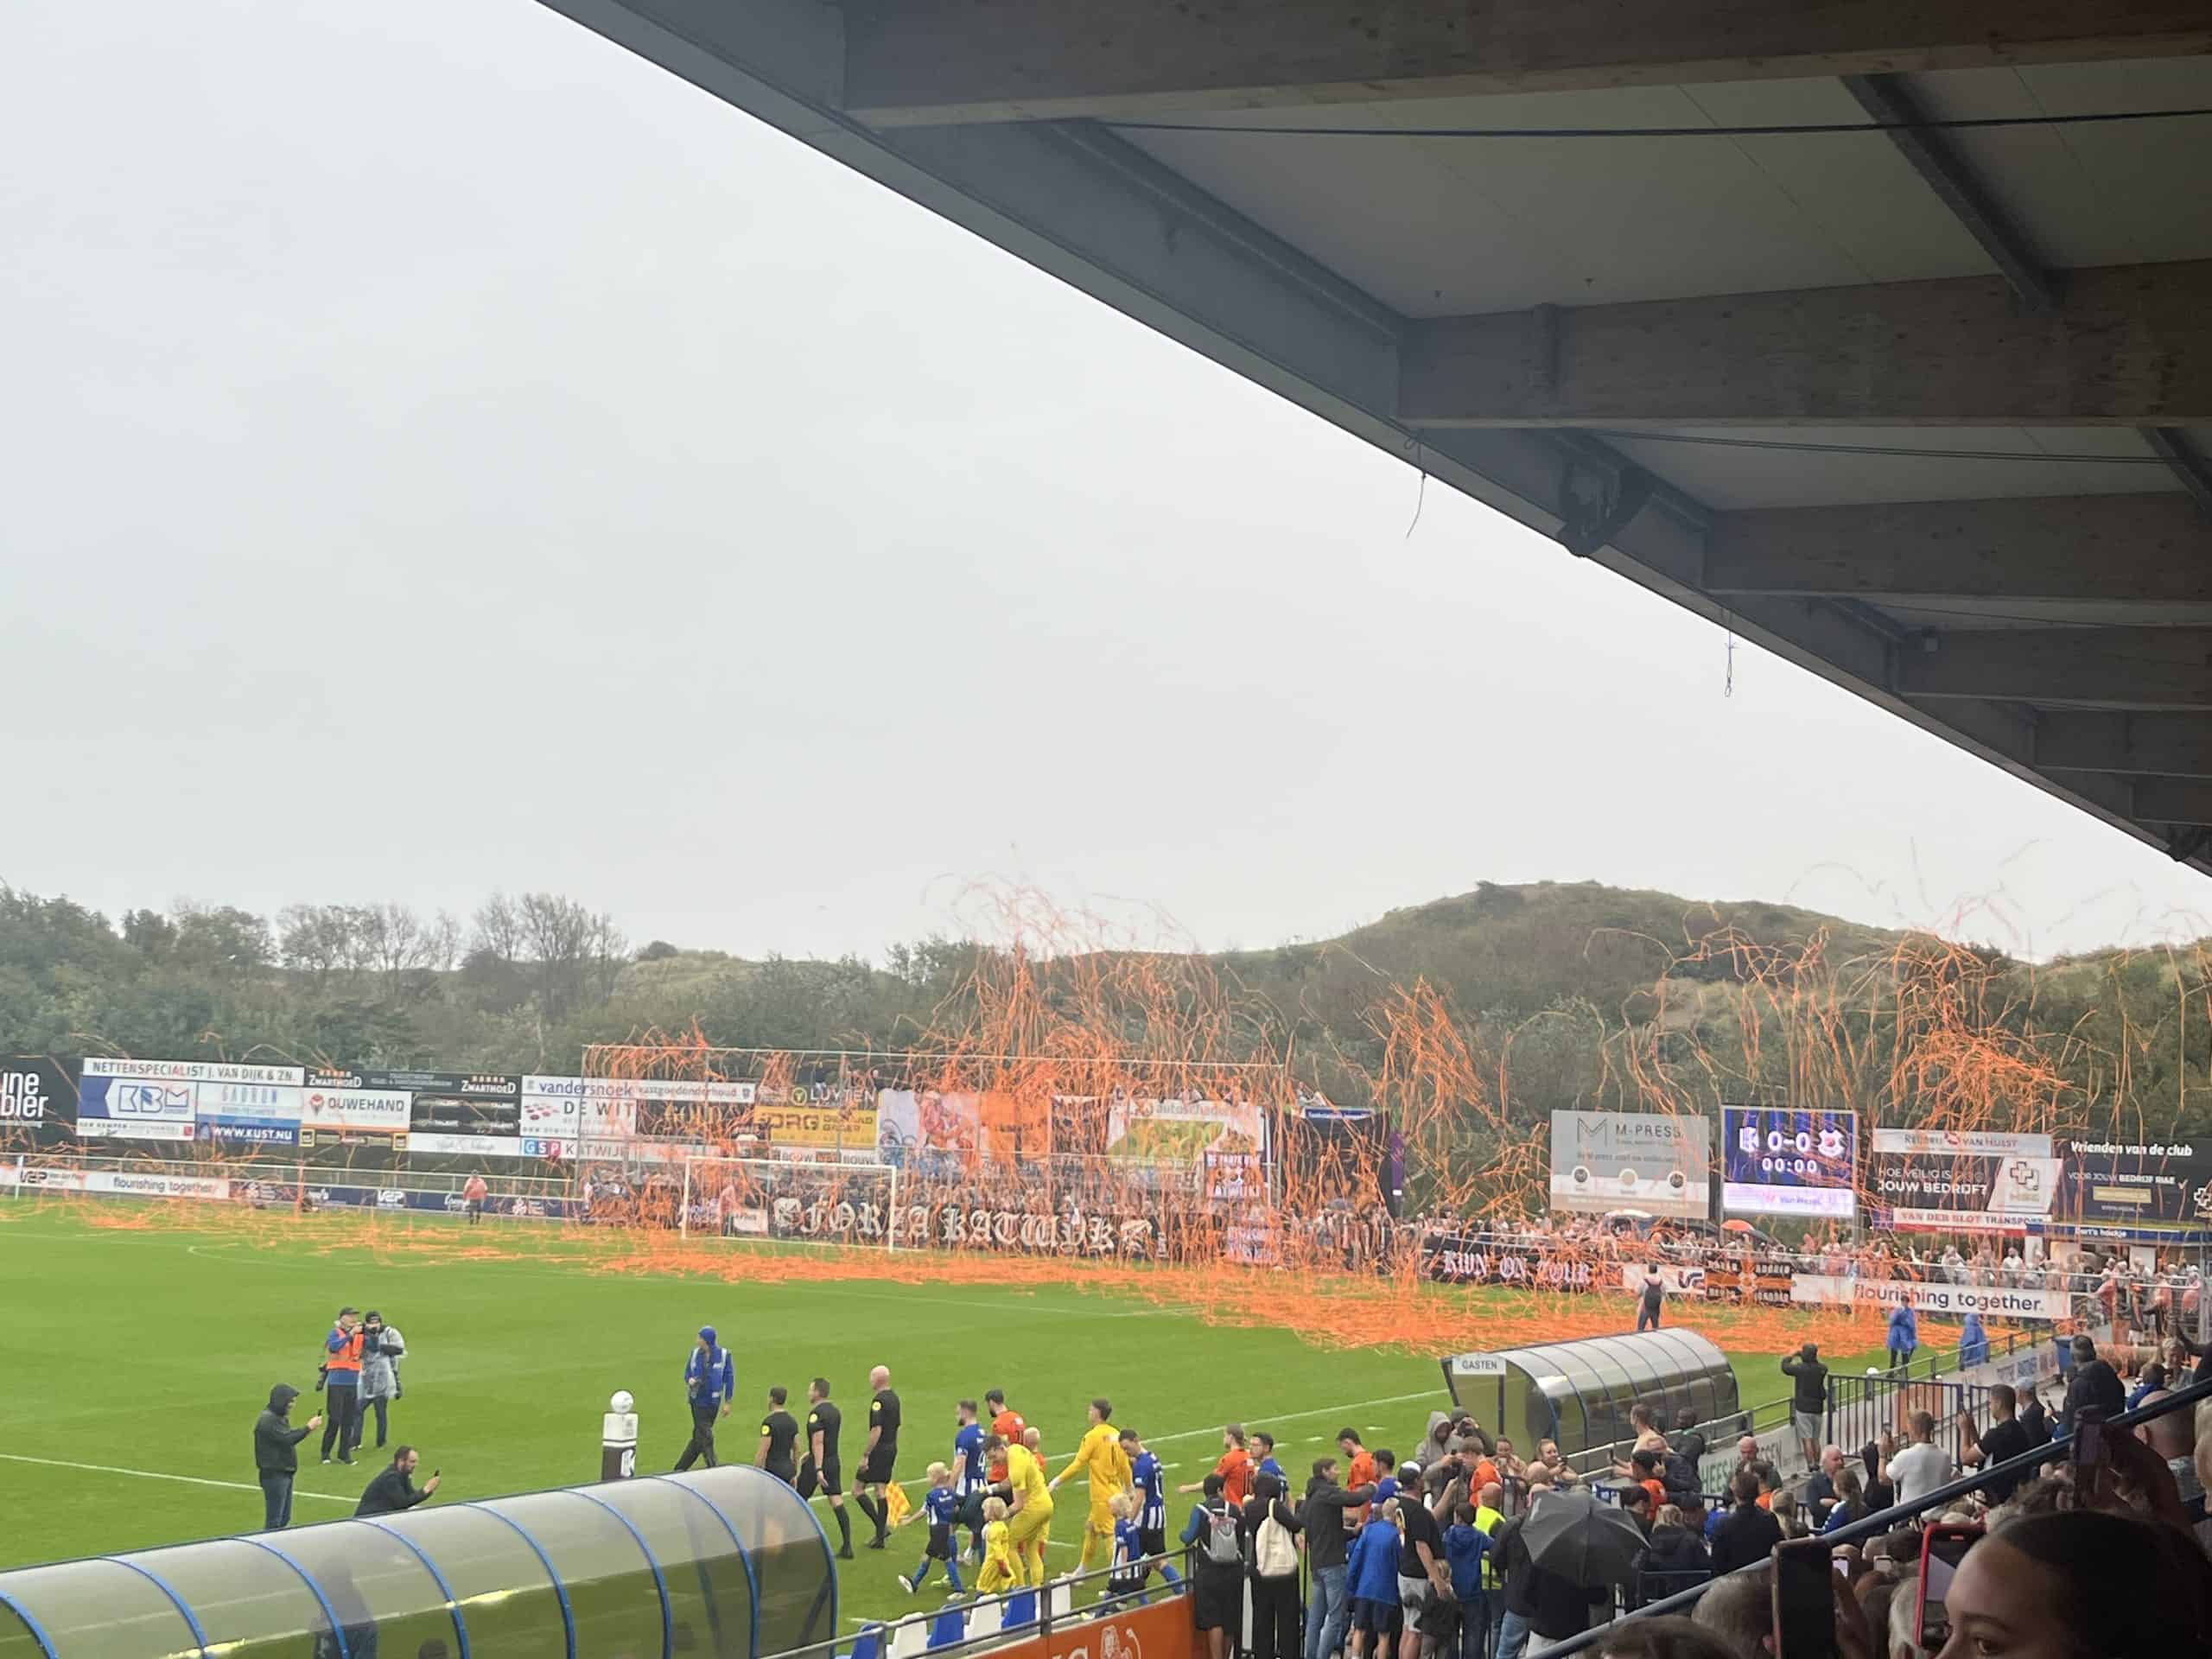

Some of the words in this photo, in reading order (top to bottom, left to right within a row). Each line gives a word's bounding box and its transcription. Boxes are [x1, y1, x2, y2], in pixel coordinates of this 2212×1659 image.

[92, 1062, 205, 1077] NETTENSPECIALIST
[218, 1068, 238, 1078] VAN
[328, 1097, 405, 1112] OUWEHAND
[213, 1125, 293, 1141] WWW.KUST.NU
[1616, 1124, 1681, 1139] M-PRESS
[524, 1140, 561, 1156] GSP
[1767, 1130, 1811, 1153] 0-0
[2070, 1140, 2123, 1154] Vrienden
[2126, 1144, 2147, 1154] van
[2149, 1143, 2164, 1155] de
[2166, 1144, 2193, 1156] club
[1762, 1157, 1818, 1173] 00:00
[1878, 1180, 1919, 1193] JOUW
[1854, 1283, 1949, 1307] flourishing
[1461, 1359, 1498, 1370] GASTEN
